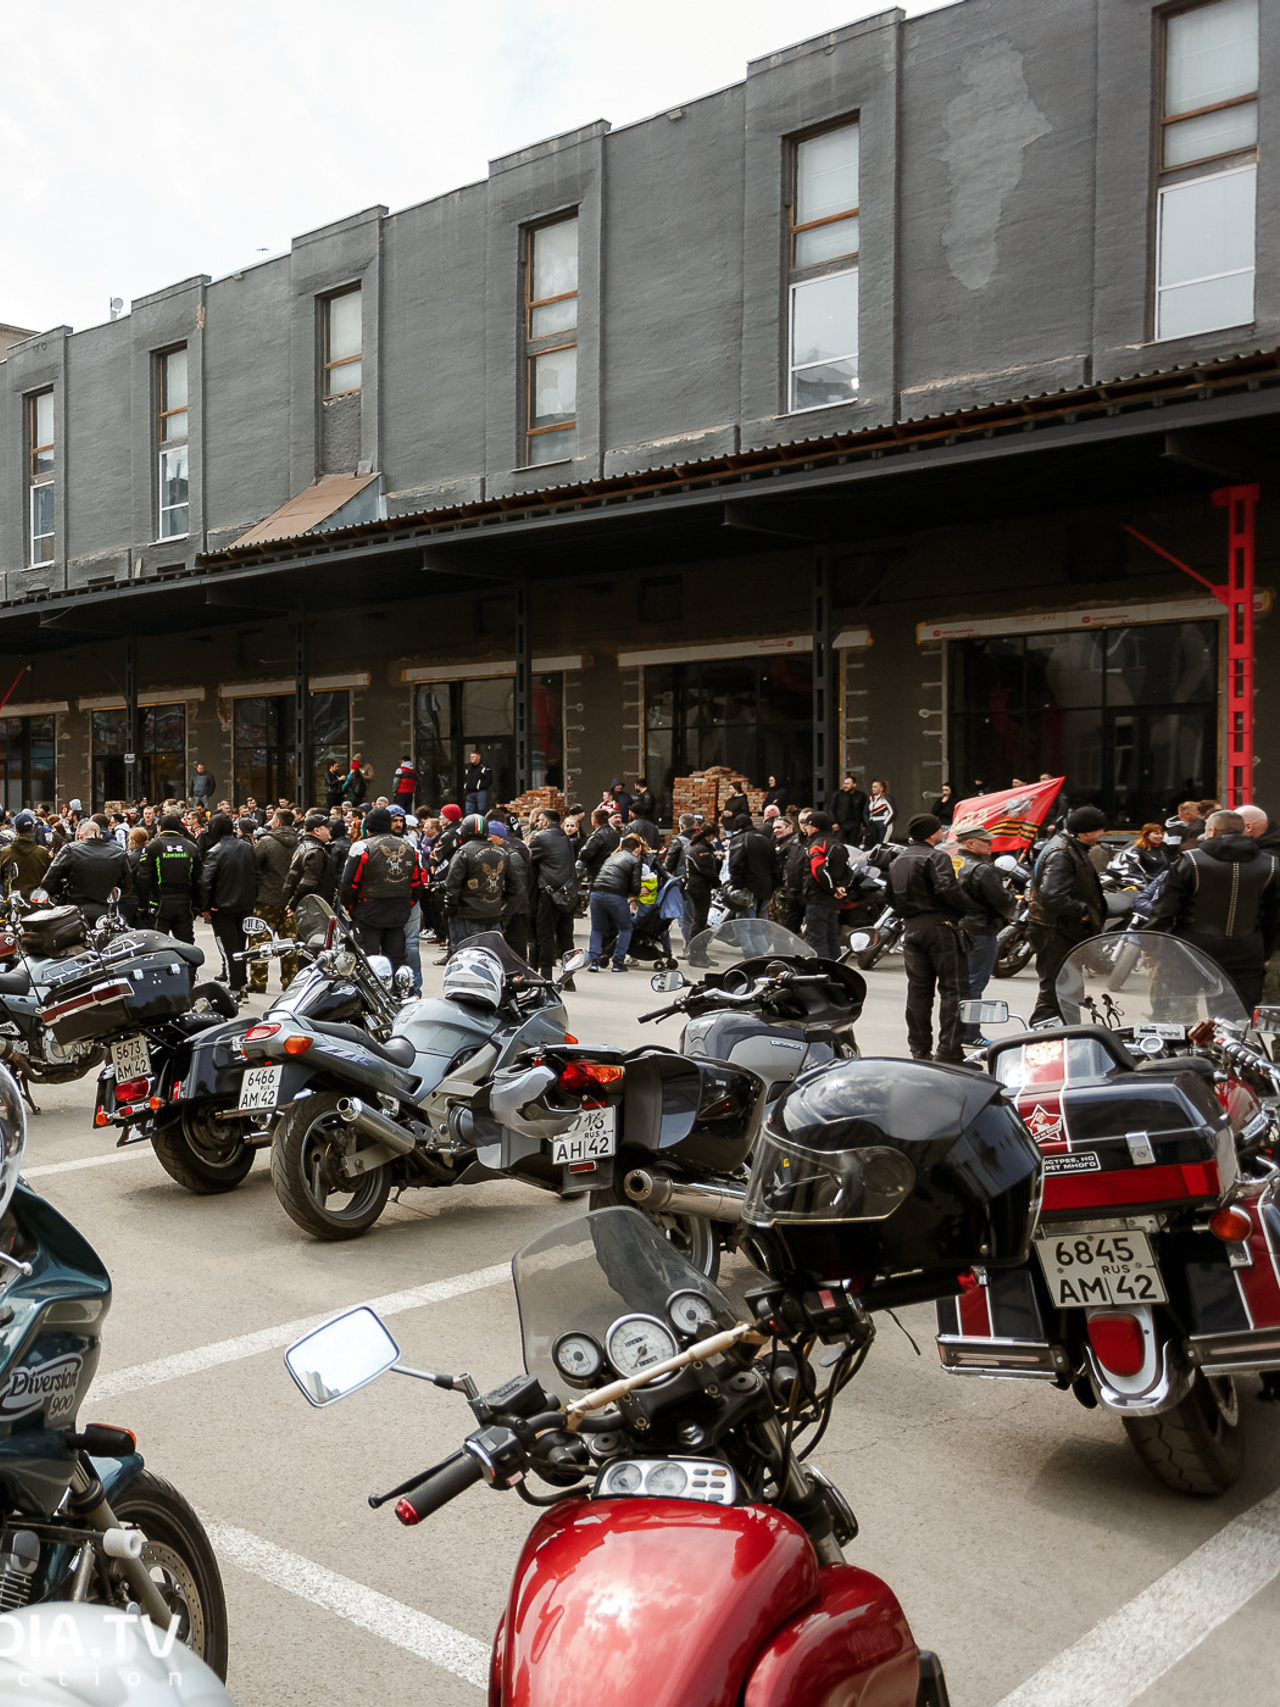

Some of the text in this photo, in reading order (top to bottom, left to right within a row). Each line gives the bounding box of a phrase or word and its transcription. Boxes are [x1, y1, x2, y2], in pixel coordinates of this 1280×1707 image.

[116, 1040, 141, 1060] 5673
[135, 1059, 148, 1074] 42
[248, 1069, 275, 1087] 6466
[261, 1090, 275, 1105] 42
[584, 1130, 600, 1139] RUS
[588, 1136, 609, 1155] 42
[1063, 1161, 1097, 1170] МНОГО
[1055, 1237, 1135, 1267] 6845
[1101, 1264, 1131, 1275] RUS
[1116, 1274, 1158, 1300] 42
[6, 1366, 78, 1398] Diversion
[49, 1393, 75, 1416] 900
